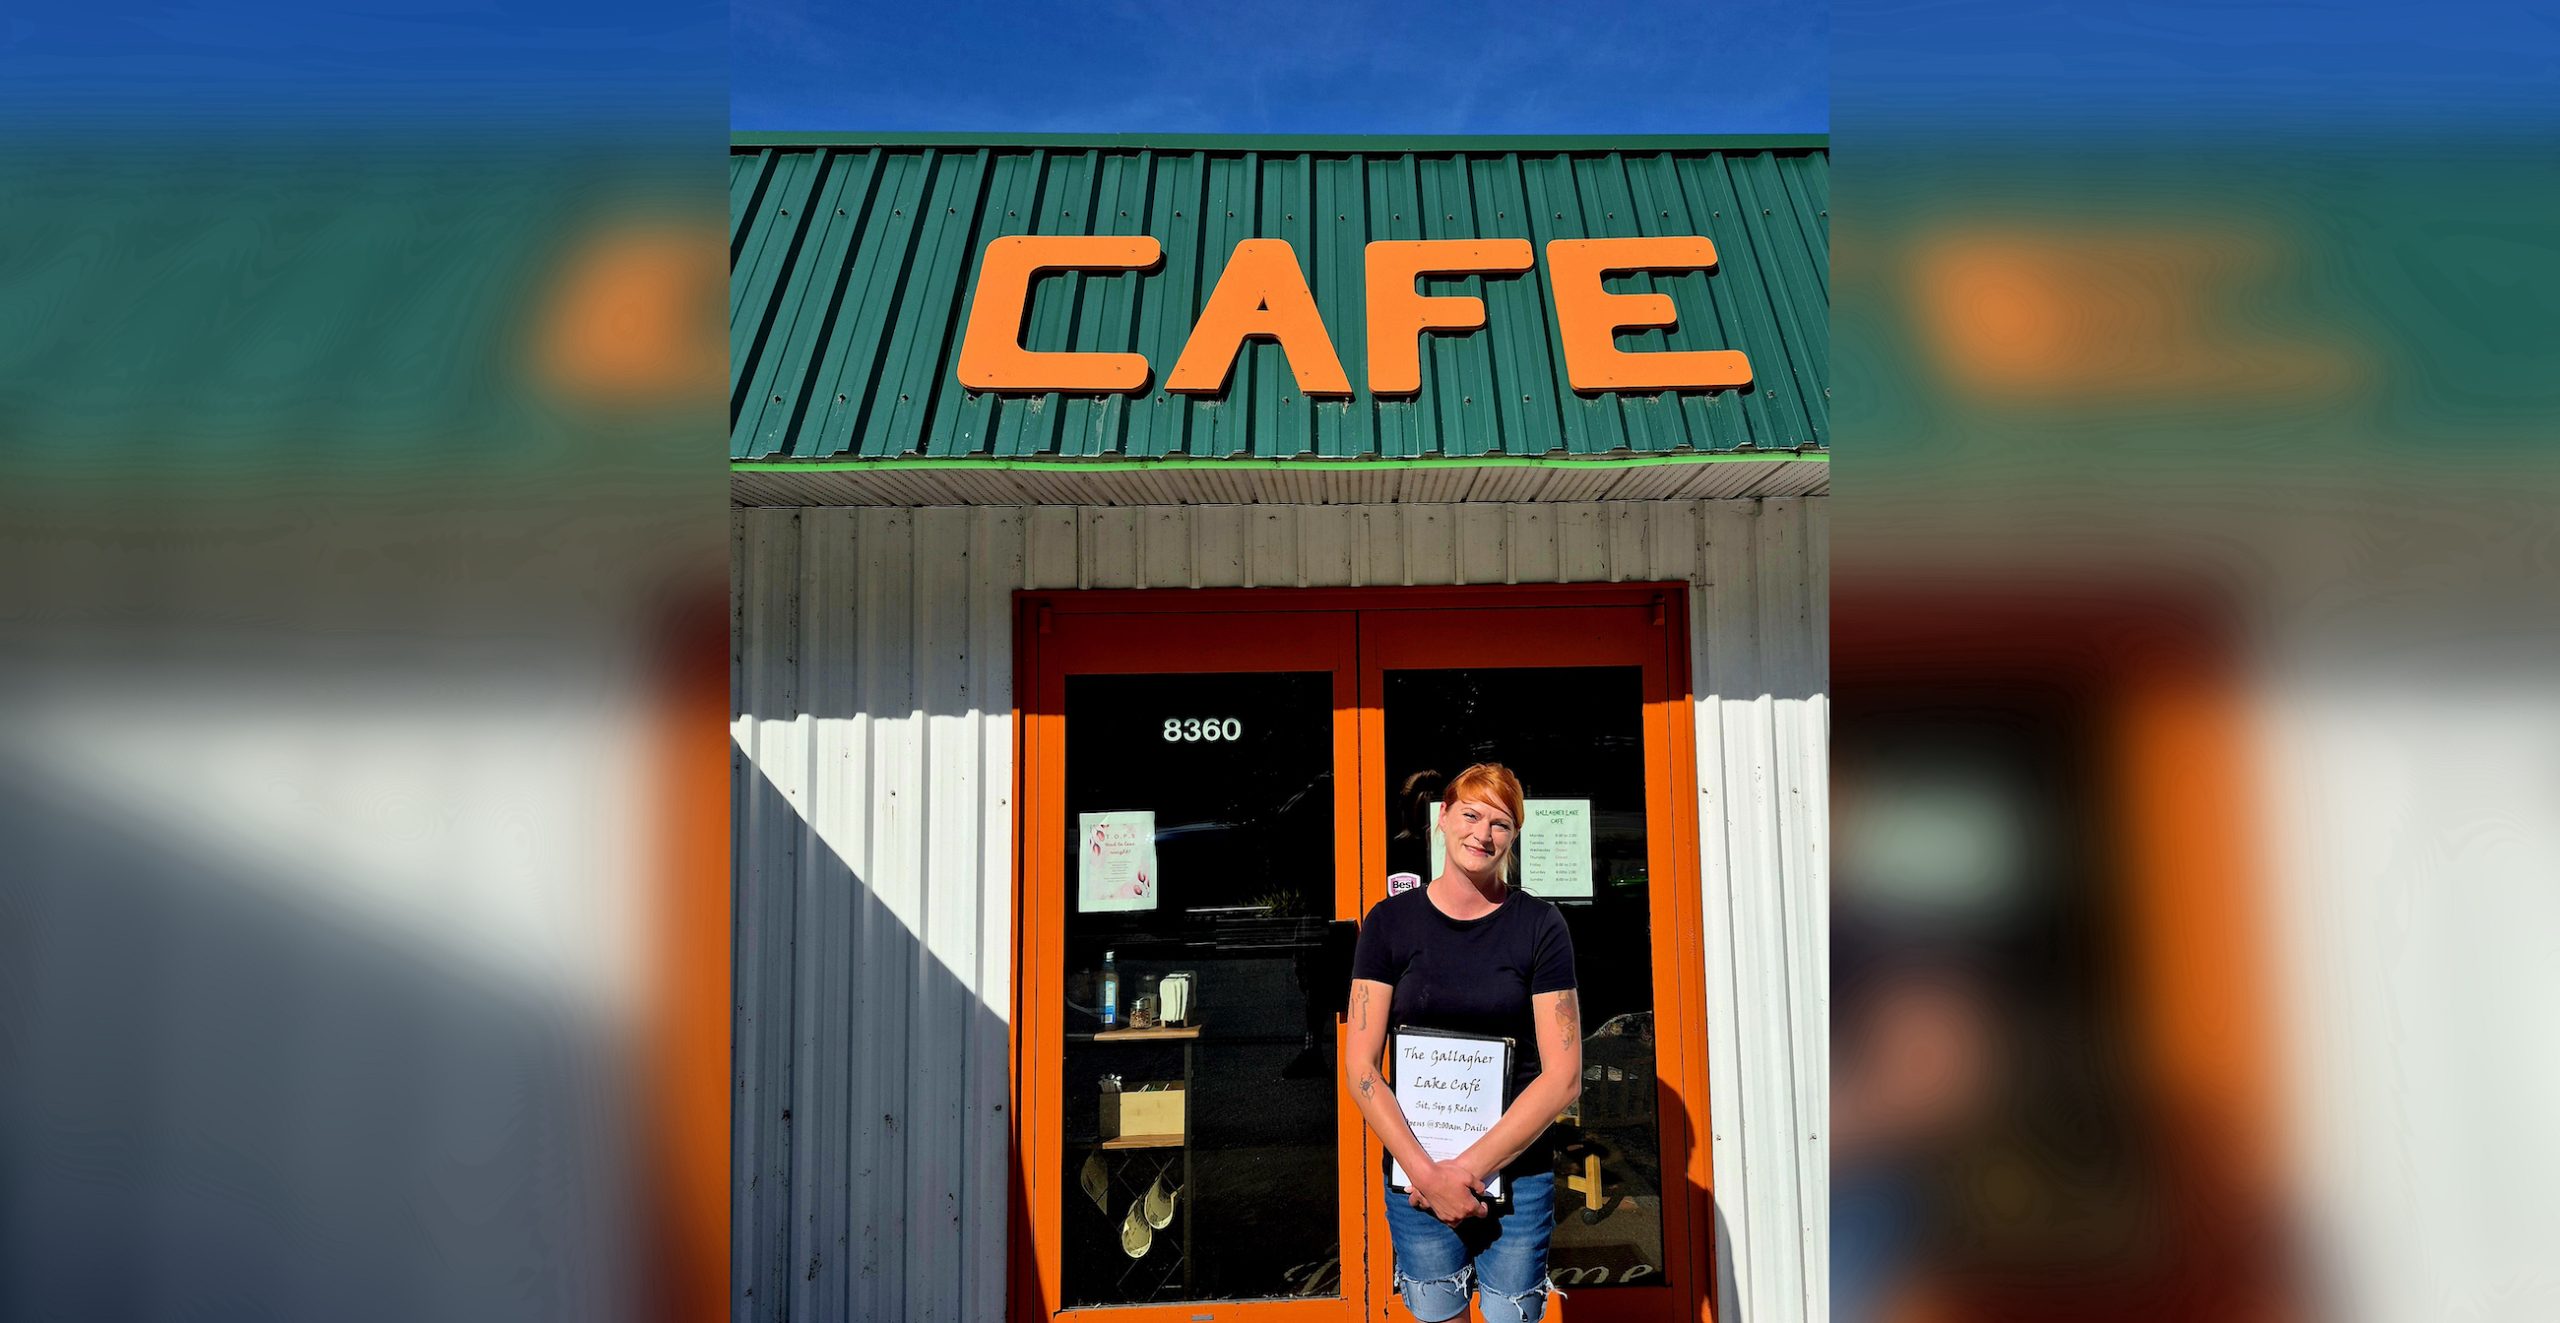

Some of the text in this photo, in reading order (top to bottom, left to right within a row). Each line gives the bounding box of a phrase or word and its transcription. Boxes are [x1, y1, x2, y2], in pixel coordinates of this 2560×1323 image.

[956, 235, 1754, 396] CAFE
[1163, 717, 1242, 742] 8360
[1392, 880, 1415, 889] Best
[1404, 1046, 1495, 1071] The Gallagher
[1413, 1076, 1481, 1099] Lake Café
[1415, 1101, 1431, 1111] Sit,
[1432, 1102, 1446, 1115] Sip
[1454, 1103, 1479, 1113] Relax
